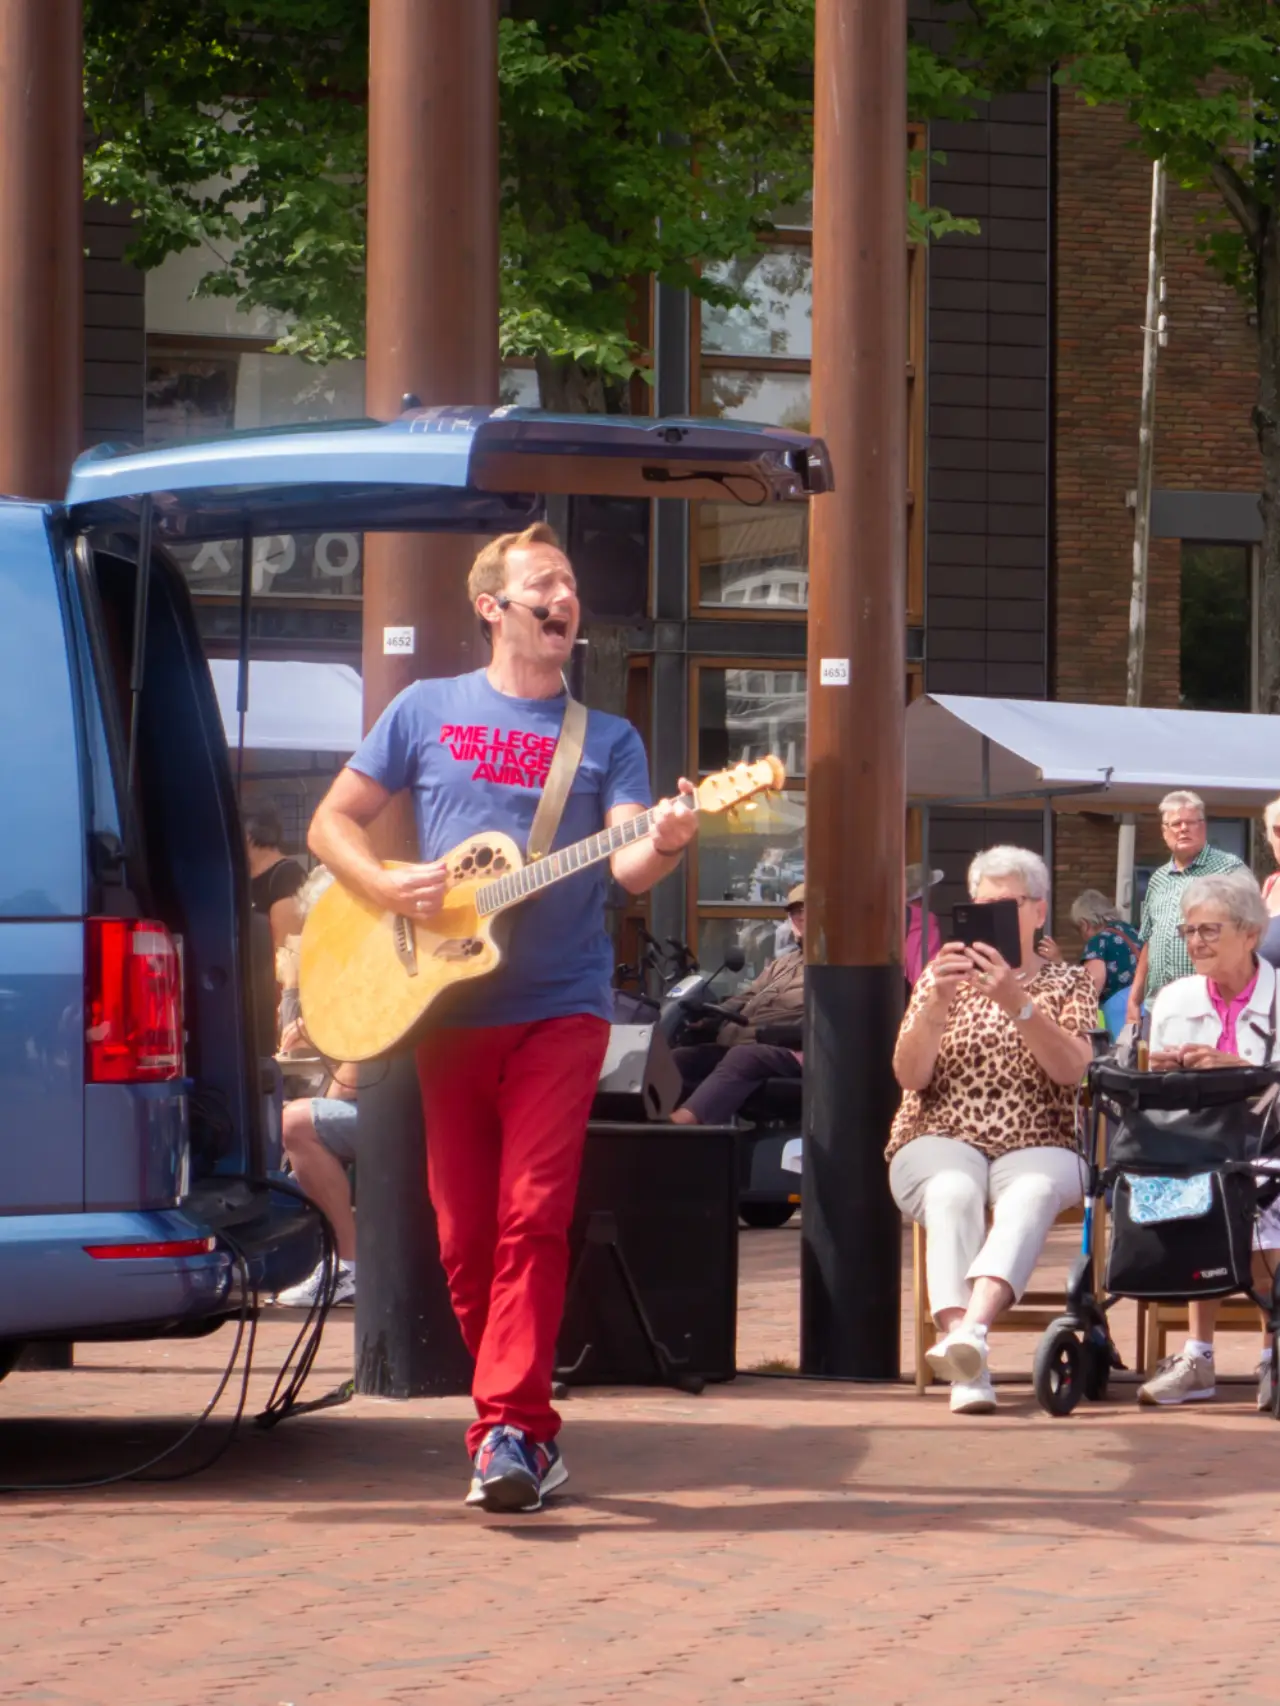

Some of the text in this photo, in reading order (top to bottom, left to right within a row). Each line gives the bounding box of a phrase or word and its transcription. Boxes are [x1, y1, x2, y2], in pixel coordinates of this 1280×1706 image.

[387, 636, 411, 646] 4652
[824, 668, 847, 678] 4653
[440, 724, 488, 744] PME
[449, 743, 554, 770] VINTAGE
